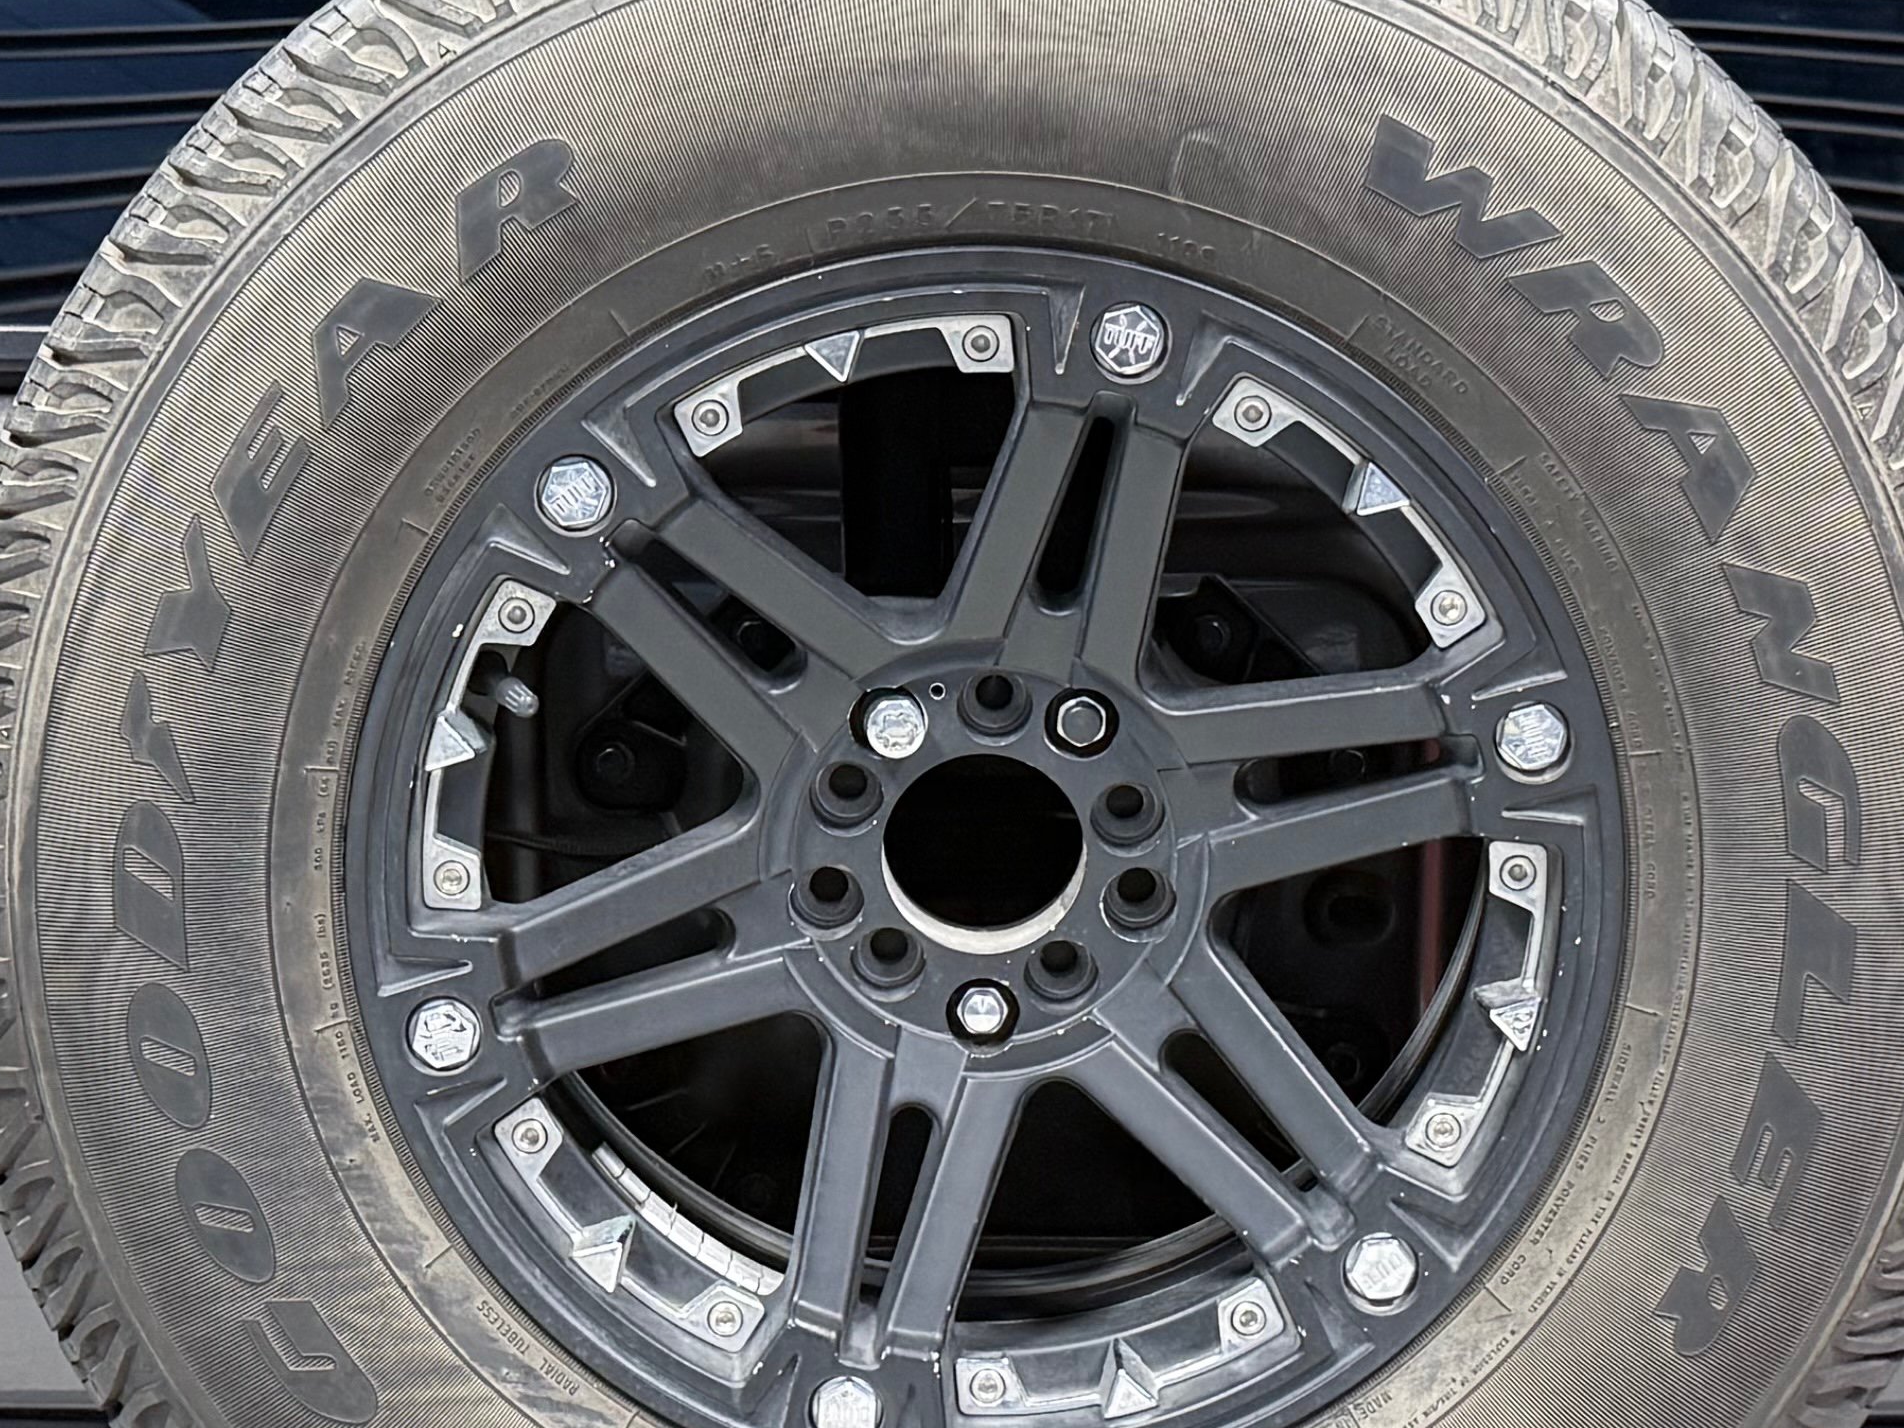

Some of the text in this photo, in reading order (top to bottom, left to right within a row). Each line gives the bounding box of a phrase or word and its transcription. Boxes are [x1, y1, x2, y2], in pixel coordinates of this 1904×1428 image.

[1366, 113, 1861, 1358] WRANGLER
[112, 138, 580, 1425] GOODYEAR
[1526, 1177, 1577, 1249] POLYESTER
[1496, 1251, 1530, 1289] CORD
[472, 1294, 582, 1399] RADIAL TUBELESS
[1353, 1385, 1395, 1421] MADE
